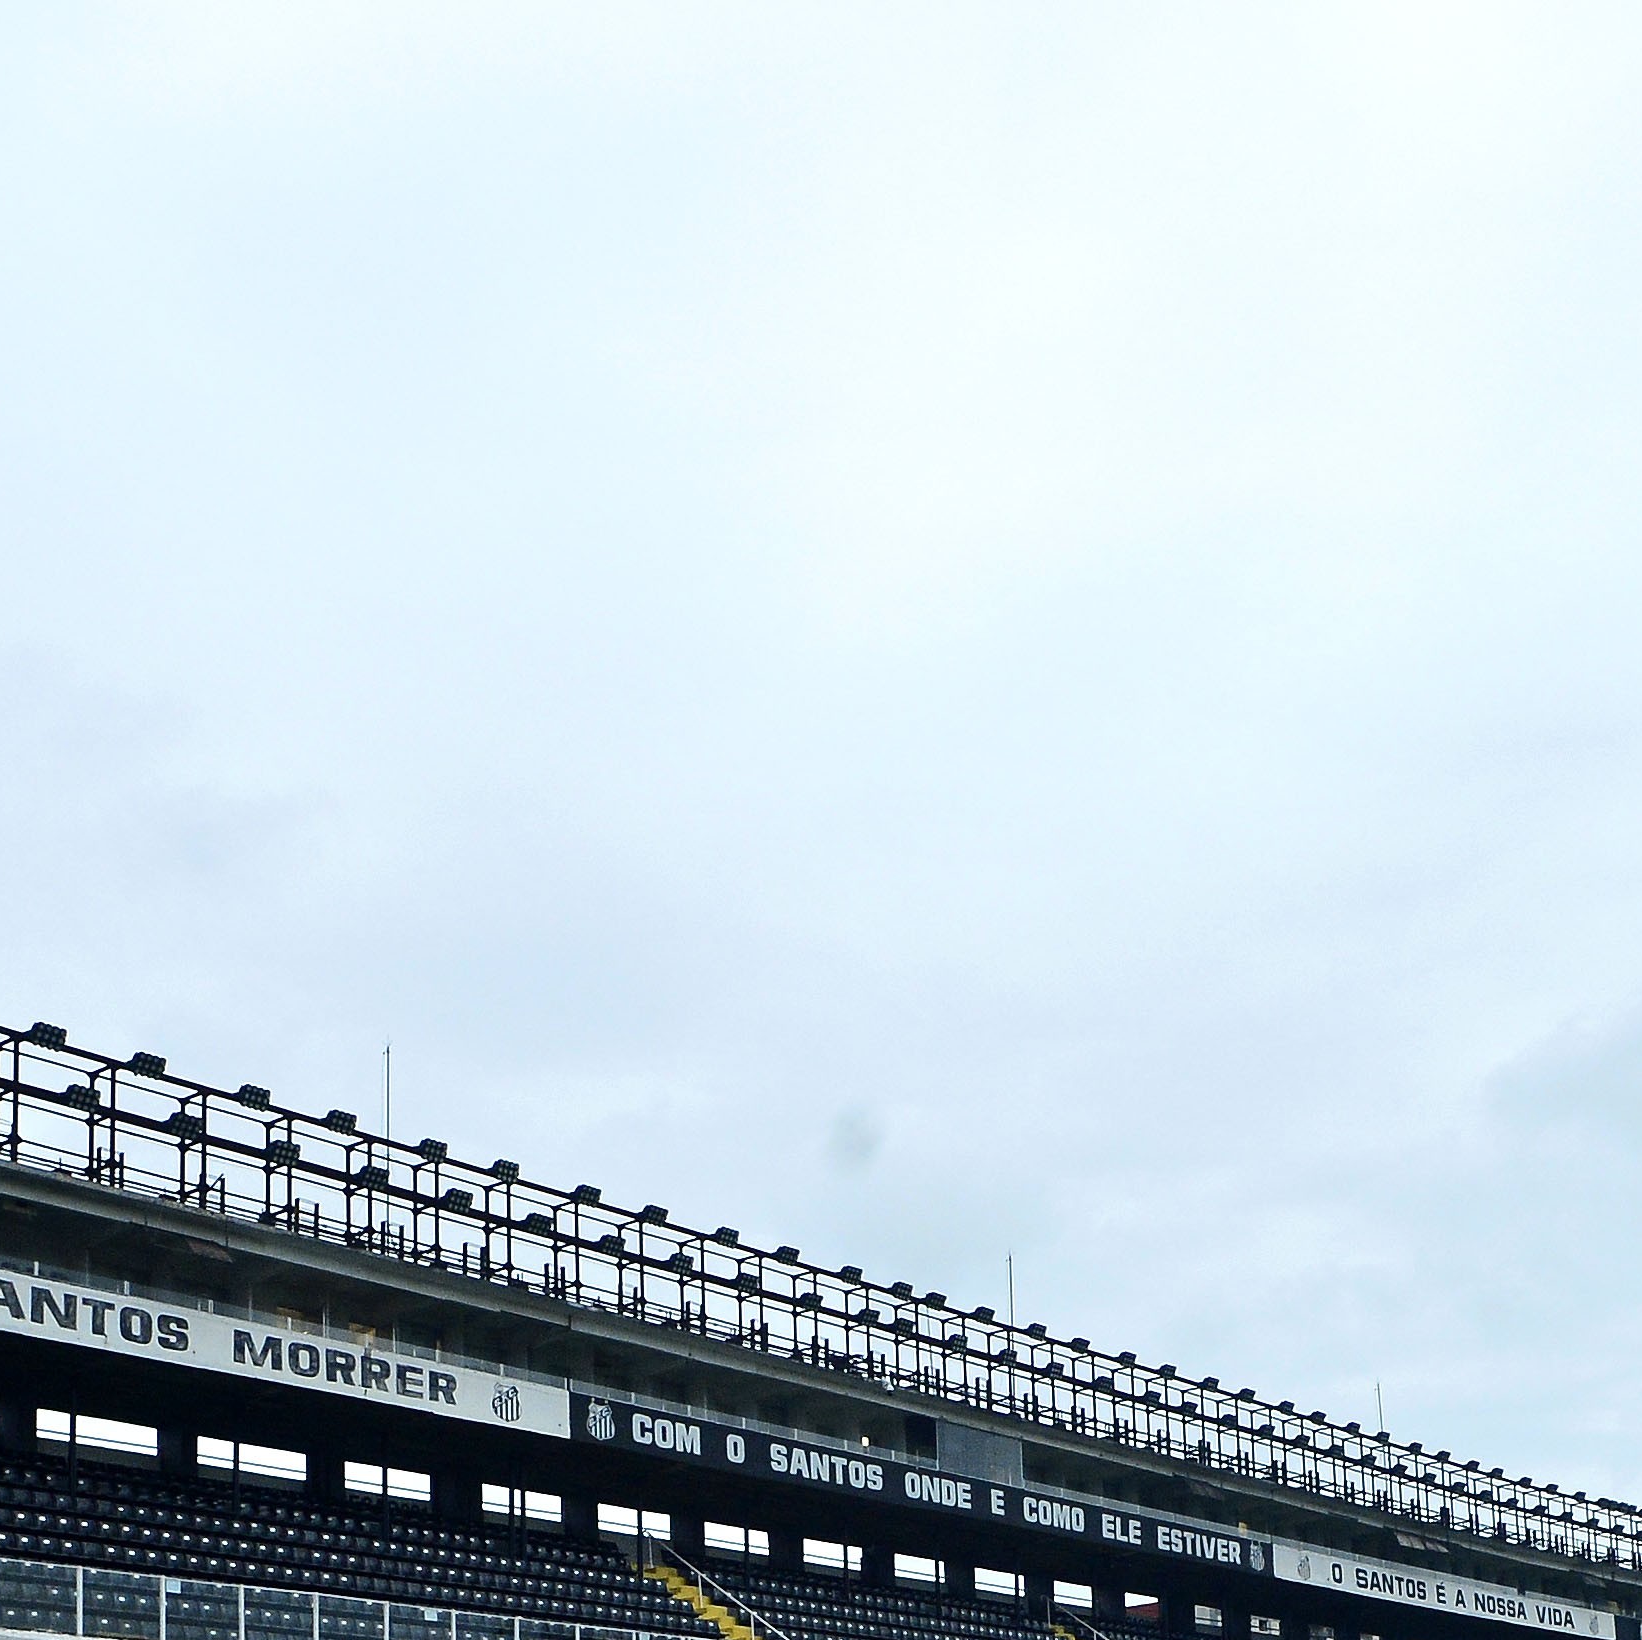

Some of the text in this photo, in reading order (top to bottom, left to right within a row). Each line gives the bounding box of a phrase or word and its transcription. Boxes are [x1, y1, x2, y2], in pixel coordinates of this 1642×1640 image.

[232, 1328, 458, 1406] MORRER
[632, 1413, 1242, 1566] COM O SANTOS ONDE E COMO ELE ESTIVER
[1331, 1563, 1576, 1630] O SANTOS É A NOSSA VIDA
